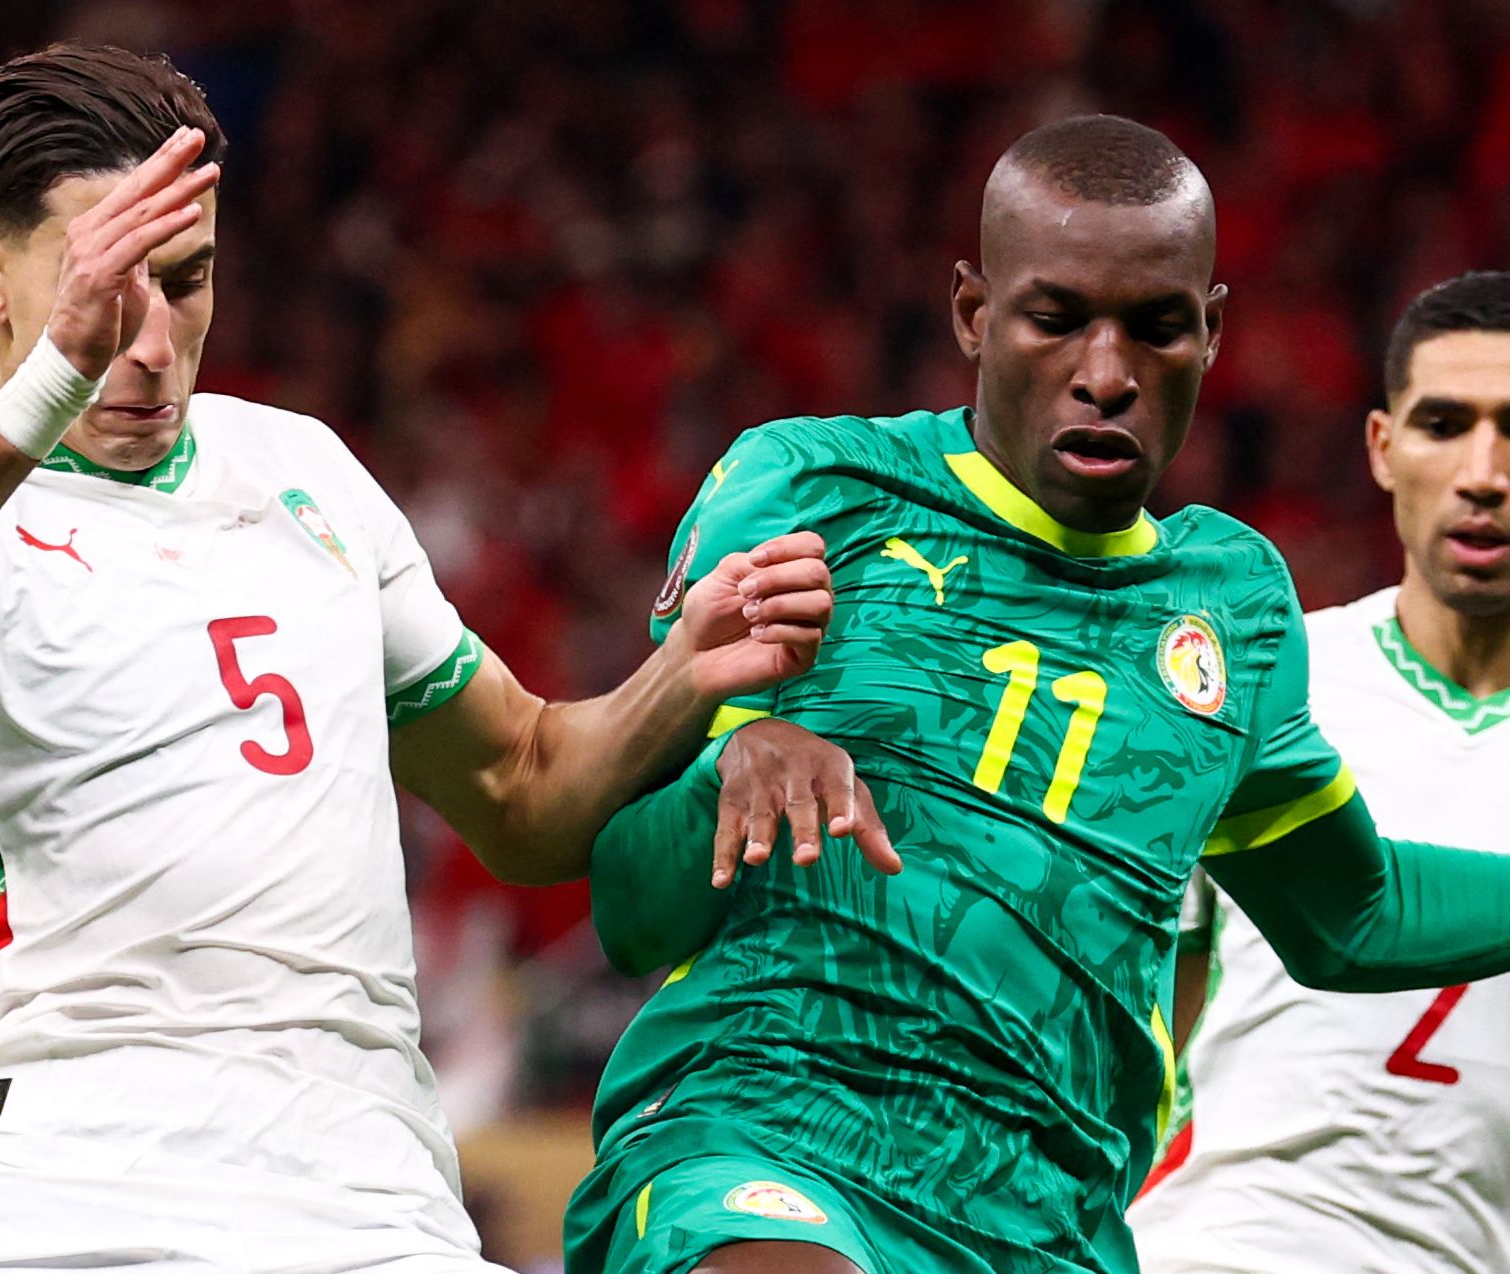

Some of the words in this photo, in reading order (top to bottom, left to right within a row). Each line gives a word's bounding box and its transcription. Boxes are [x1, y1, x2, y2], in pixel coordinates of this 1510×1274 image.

[207, 614, 315, 776] 5
[974, 641, 1106, 822] 11
[1384, 983, 1470, 1087] 2
